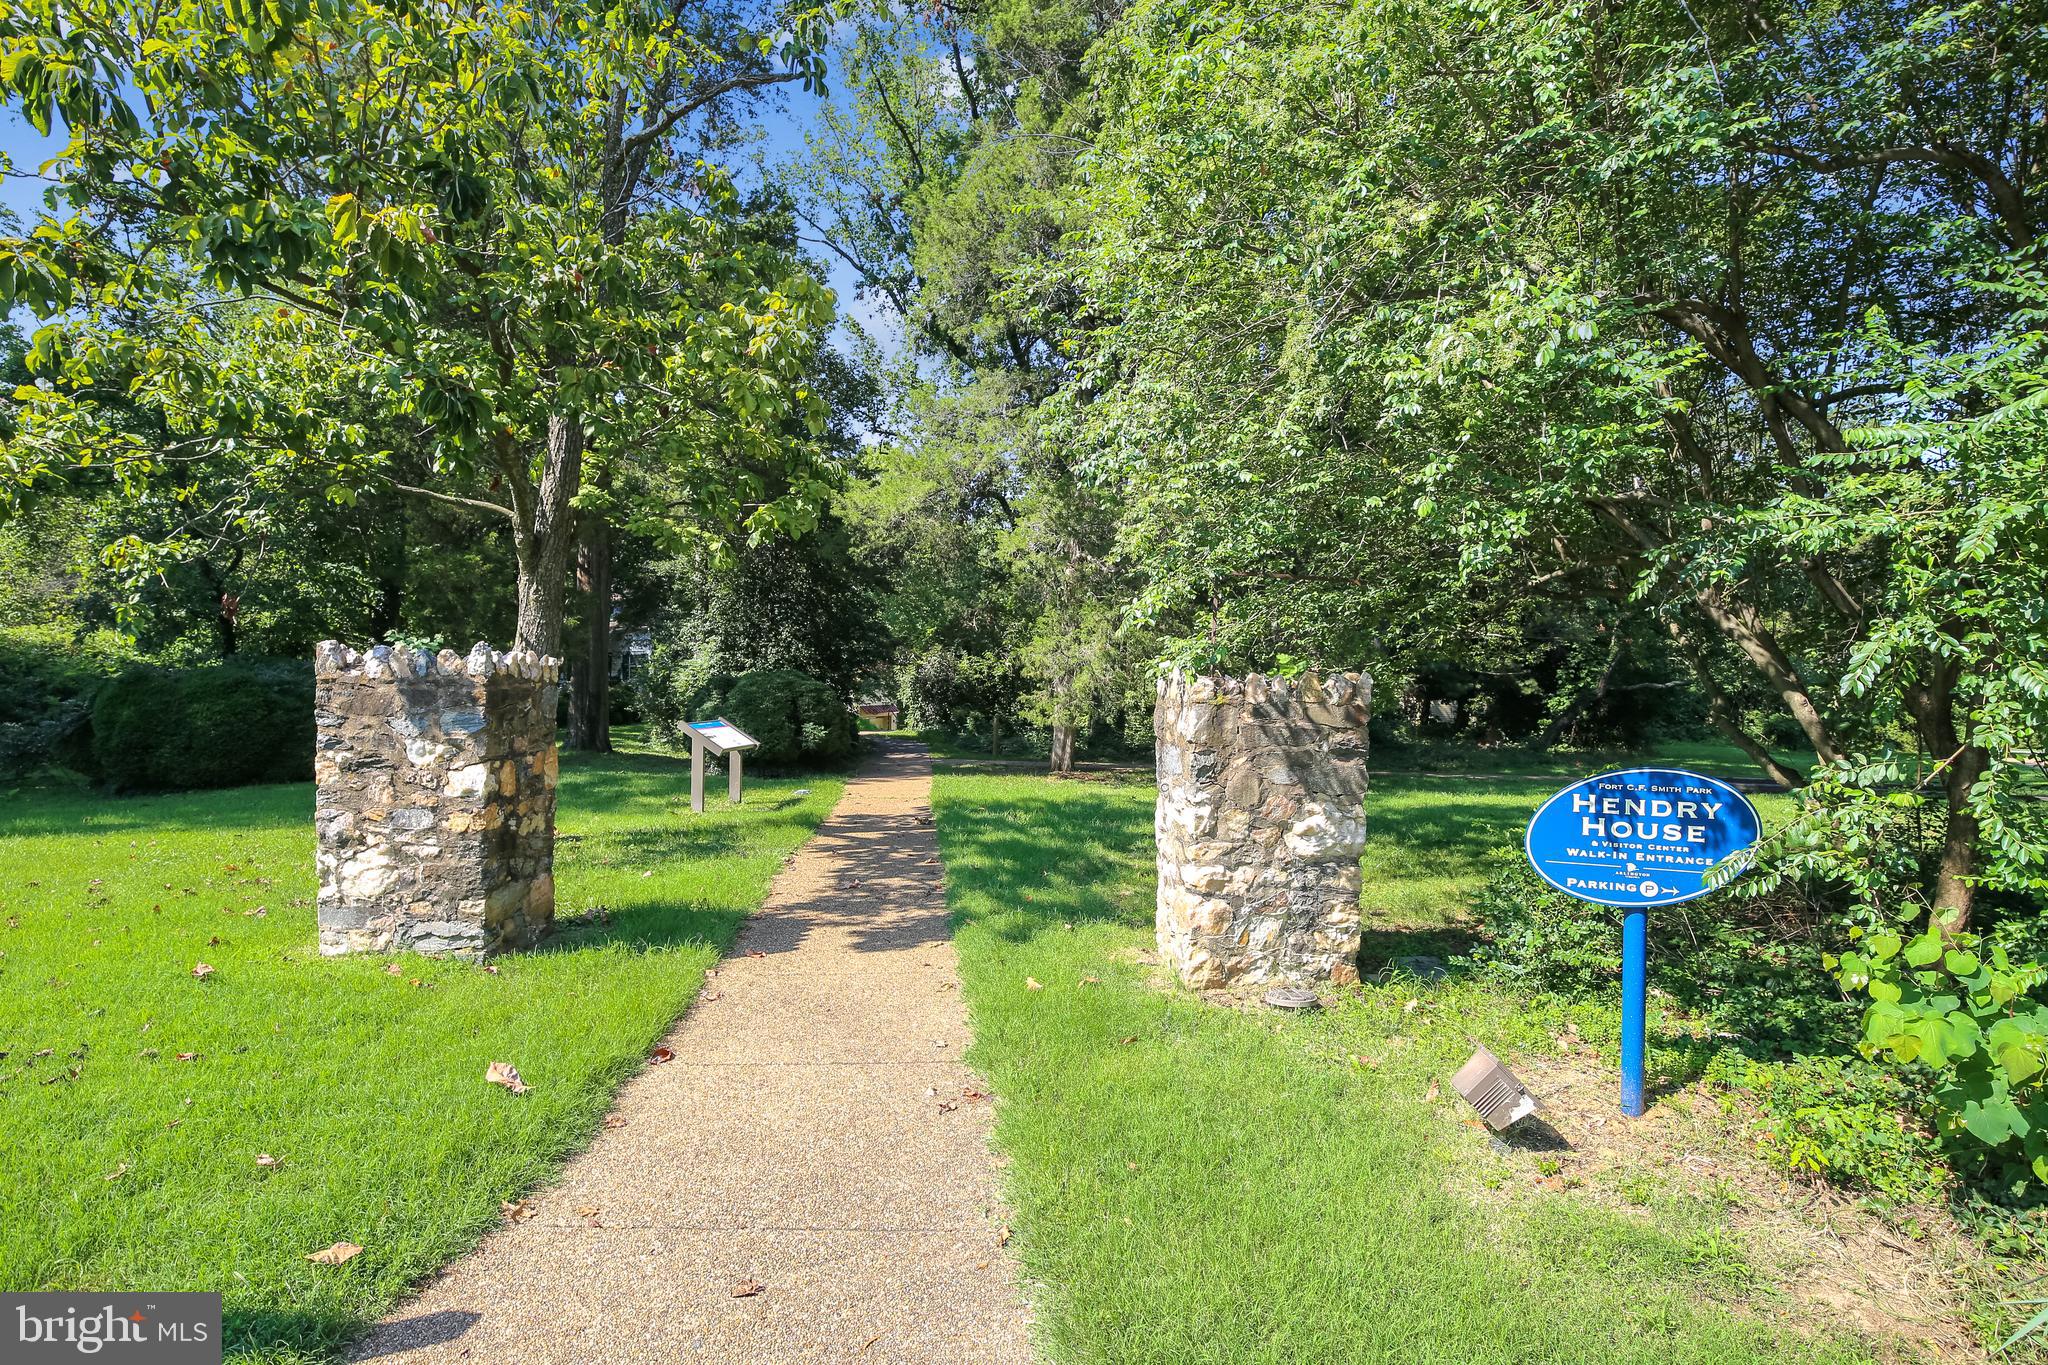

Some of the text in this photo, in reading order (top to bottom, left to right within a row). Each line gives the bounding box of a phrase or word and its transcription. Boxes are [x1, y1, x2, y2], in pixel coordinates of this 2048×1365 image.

[1572, 793, 1723, 819] HENDRY
[1582, 817, 1705, 843] HOUSE
[1602, 841, 1643, 850] VISITOR
[1648, 844, 1689, 852] CENTER
[1566, 848, 1714, 866] WALK-IN ENTRANCE
[1566, 878, 1637, 892] PARKING
